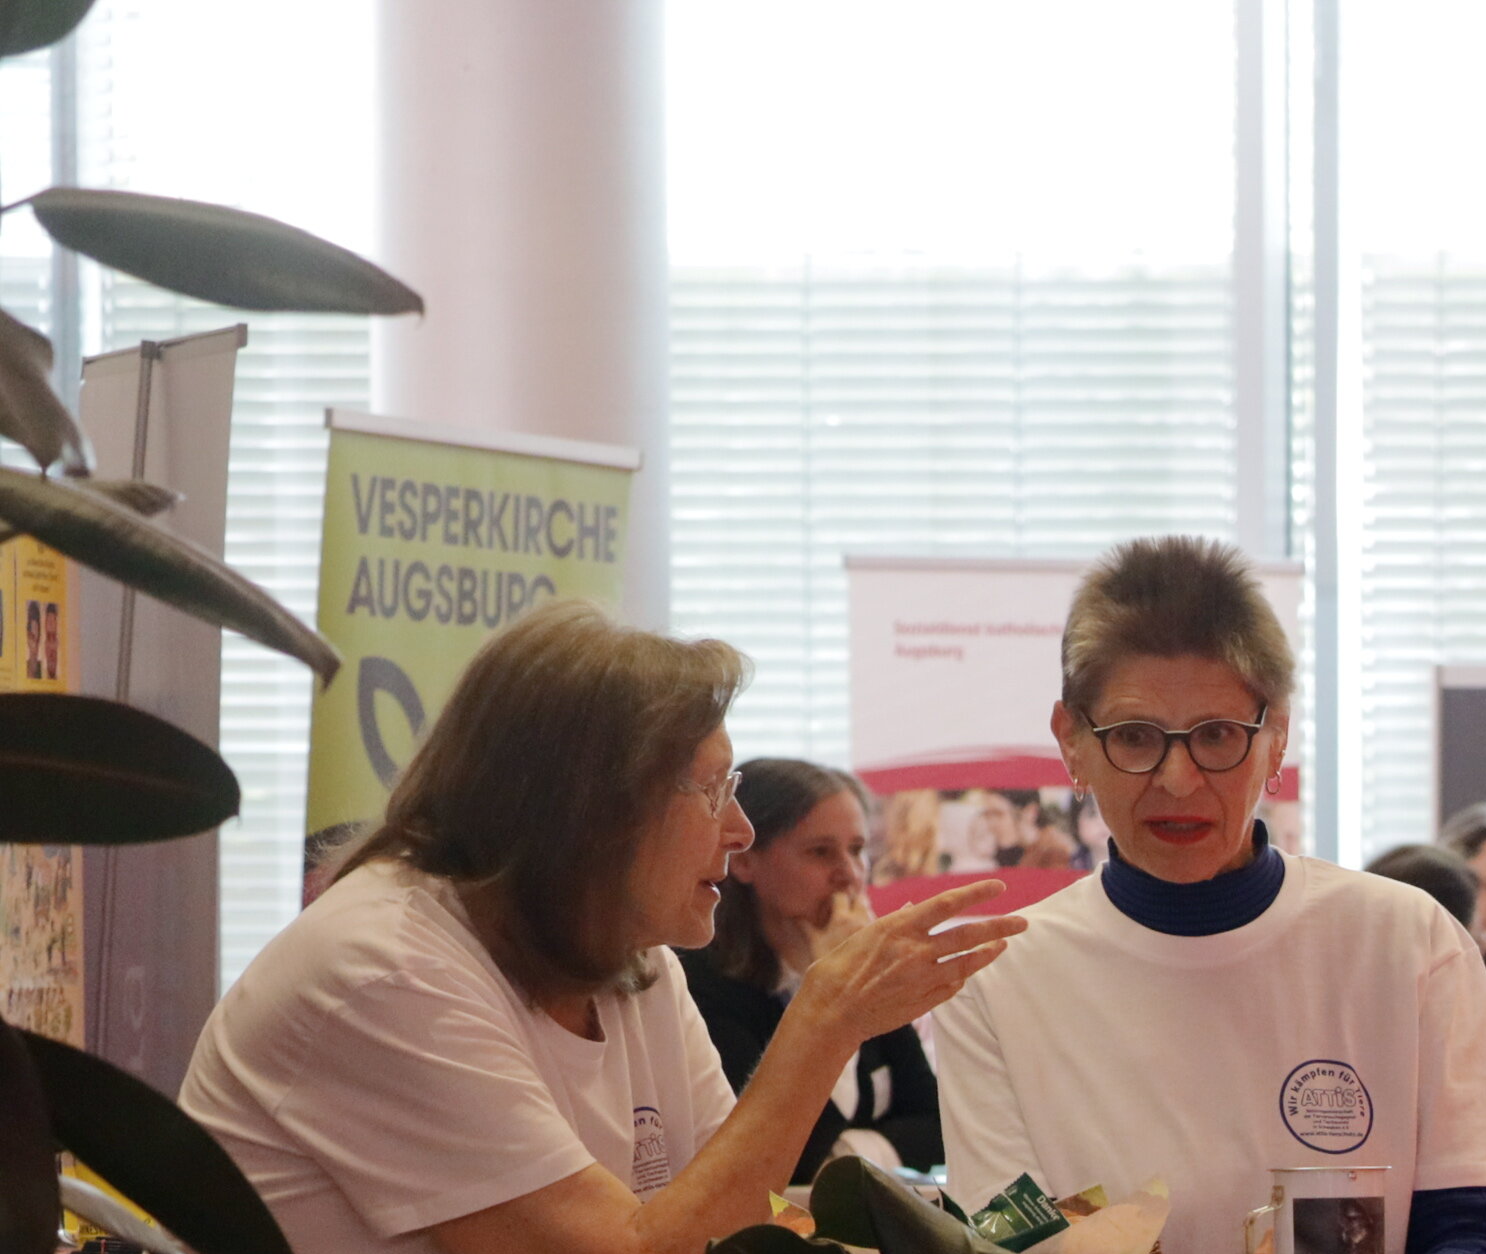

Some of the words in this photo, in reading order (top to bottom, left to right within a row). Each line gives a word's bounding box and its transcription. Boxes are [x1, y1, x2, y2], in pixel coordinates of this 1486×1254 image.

[352, 473, 618, 563] VESPERKIRCHE
[1291, 1067, 1335, 1093] kämpfen
[1338, 1070, 1355, 1085] für
[1288, 1096, 1299, 1116] Wir
[1036, 1195, 1060, 1221] Danke
